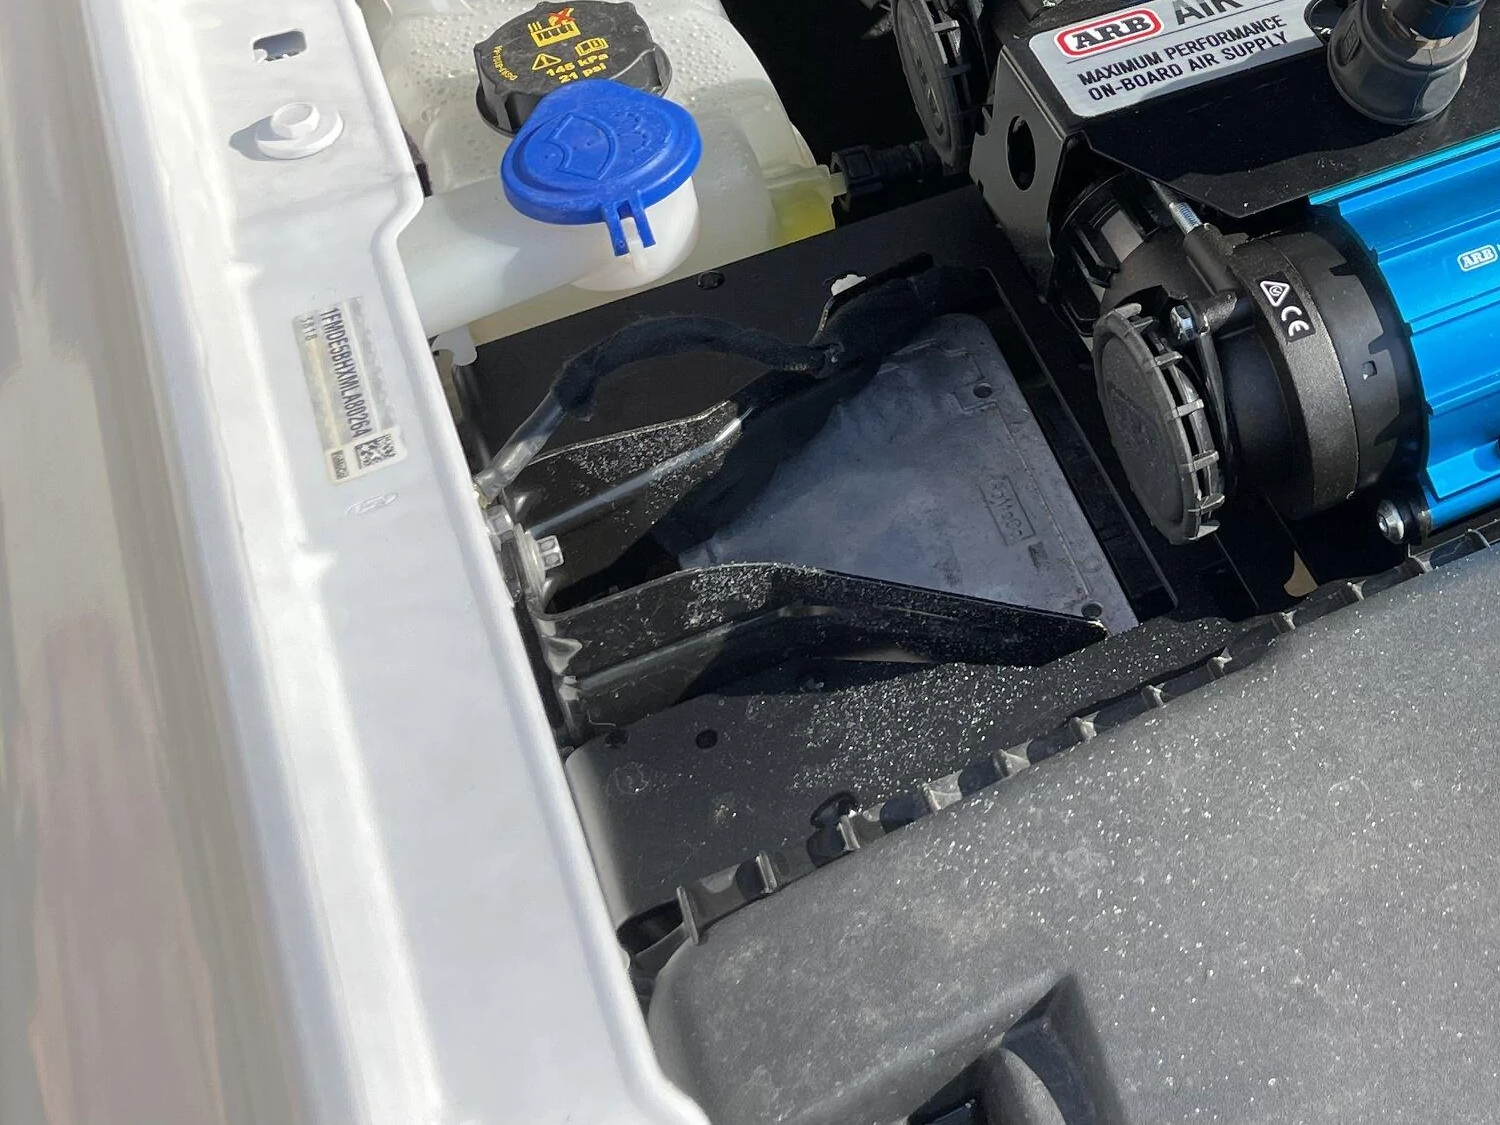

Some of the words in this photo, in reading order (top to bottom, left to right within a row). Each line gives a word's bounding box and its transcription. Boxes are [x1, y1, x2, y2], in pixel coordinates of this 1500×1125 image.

[1070, 14, 1154, 52] ARB
[546, 62, 575, 77] 145
[577, 53, 609, 67] kPa
[1077, 51, 1164, 87] MAXIMUM
[1167, 14, 1288, 60] PERFORMANCE
[558, 71, 578, 84] 21
[583, 62, 607, 77] psi
[1088, 62, 1183, 102] ON-BOARD
[1190, 53, 1220, 73] AIR
[1225, 31, 1289, 61] SUPPLY
[1460, 246, 1496, 269] ARB
